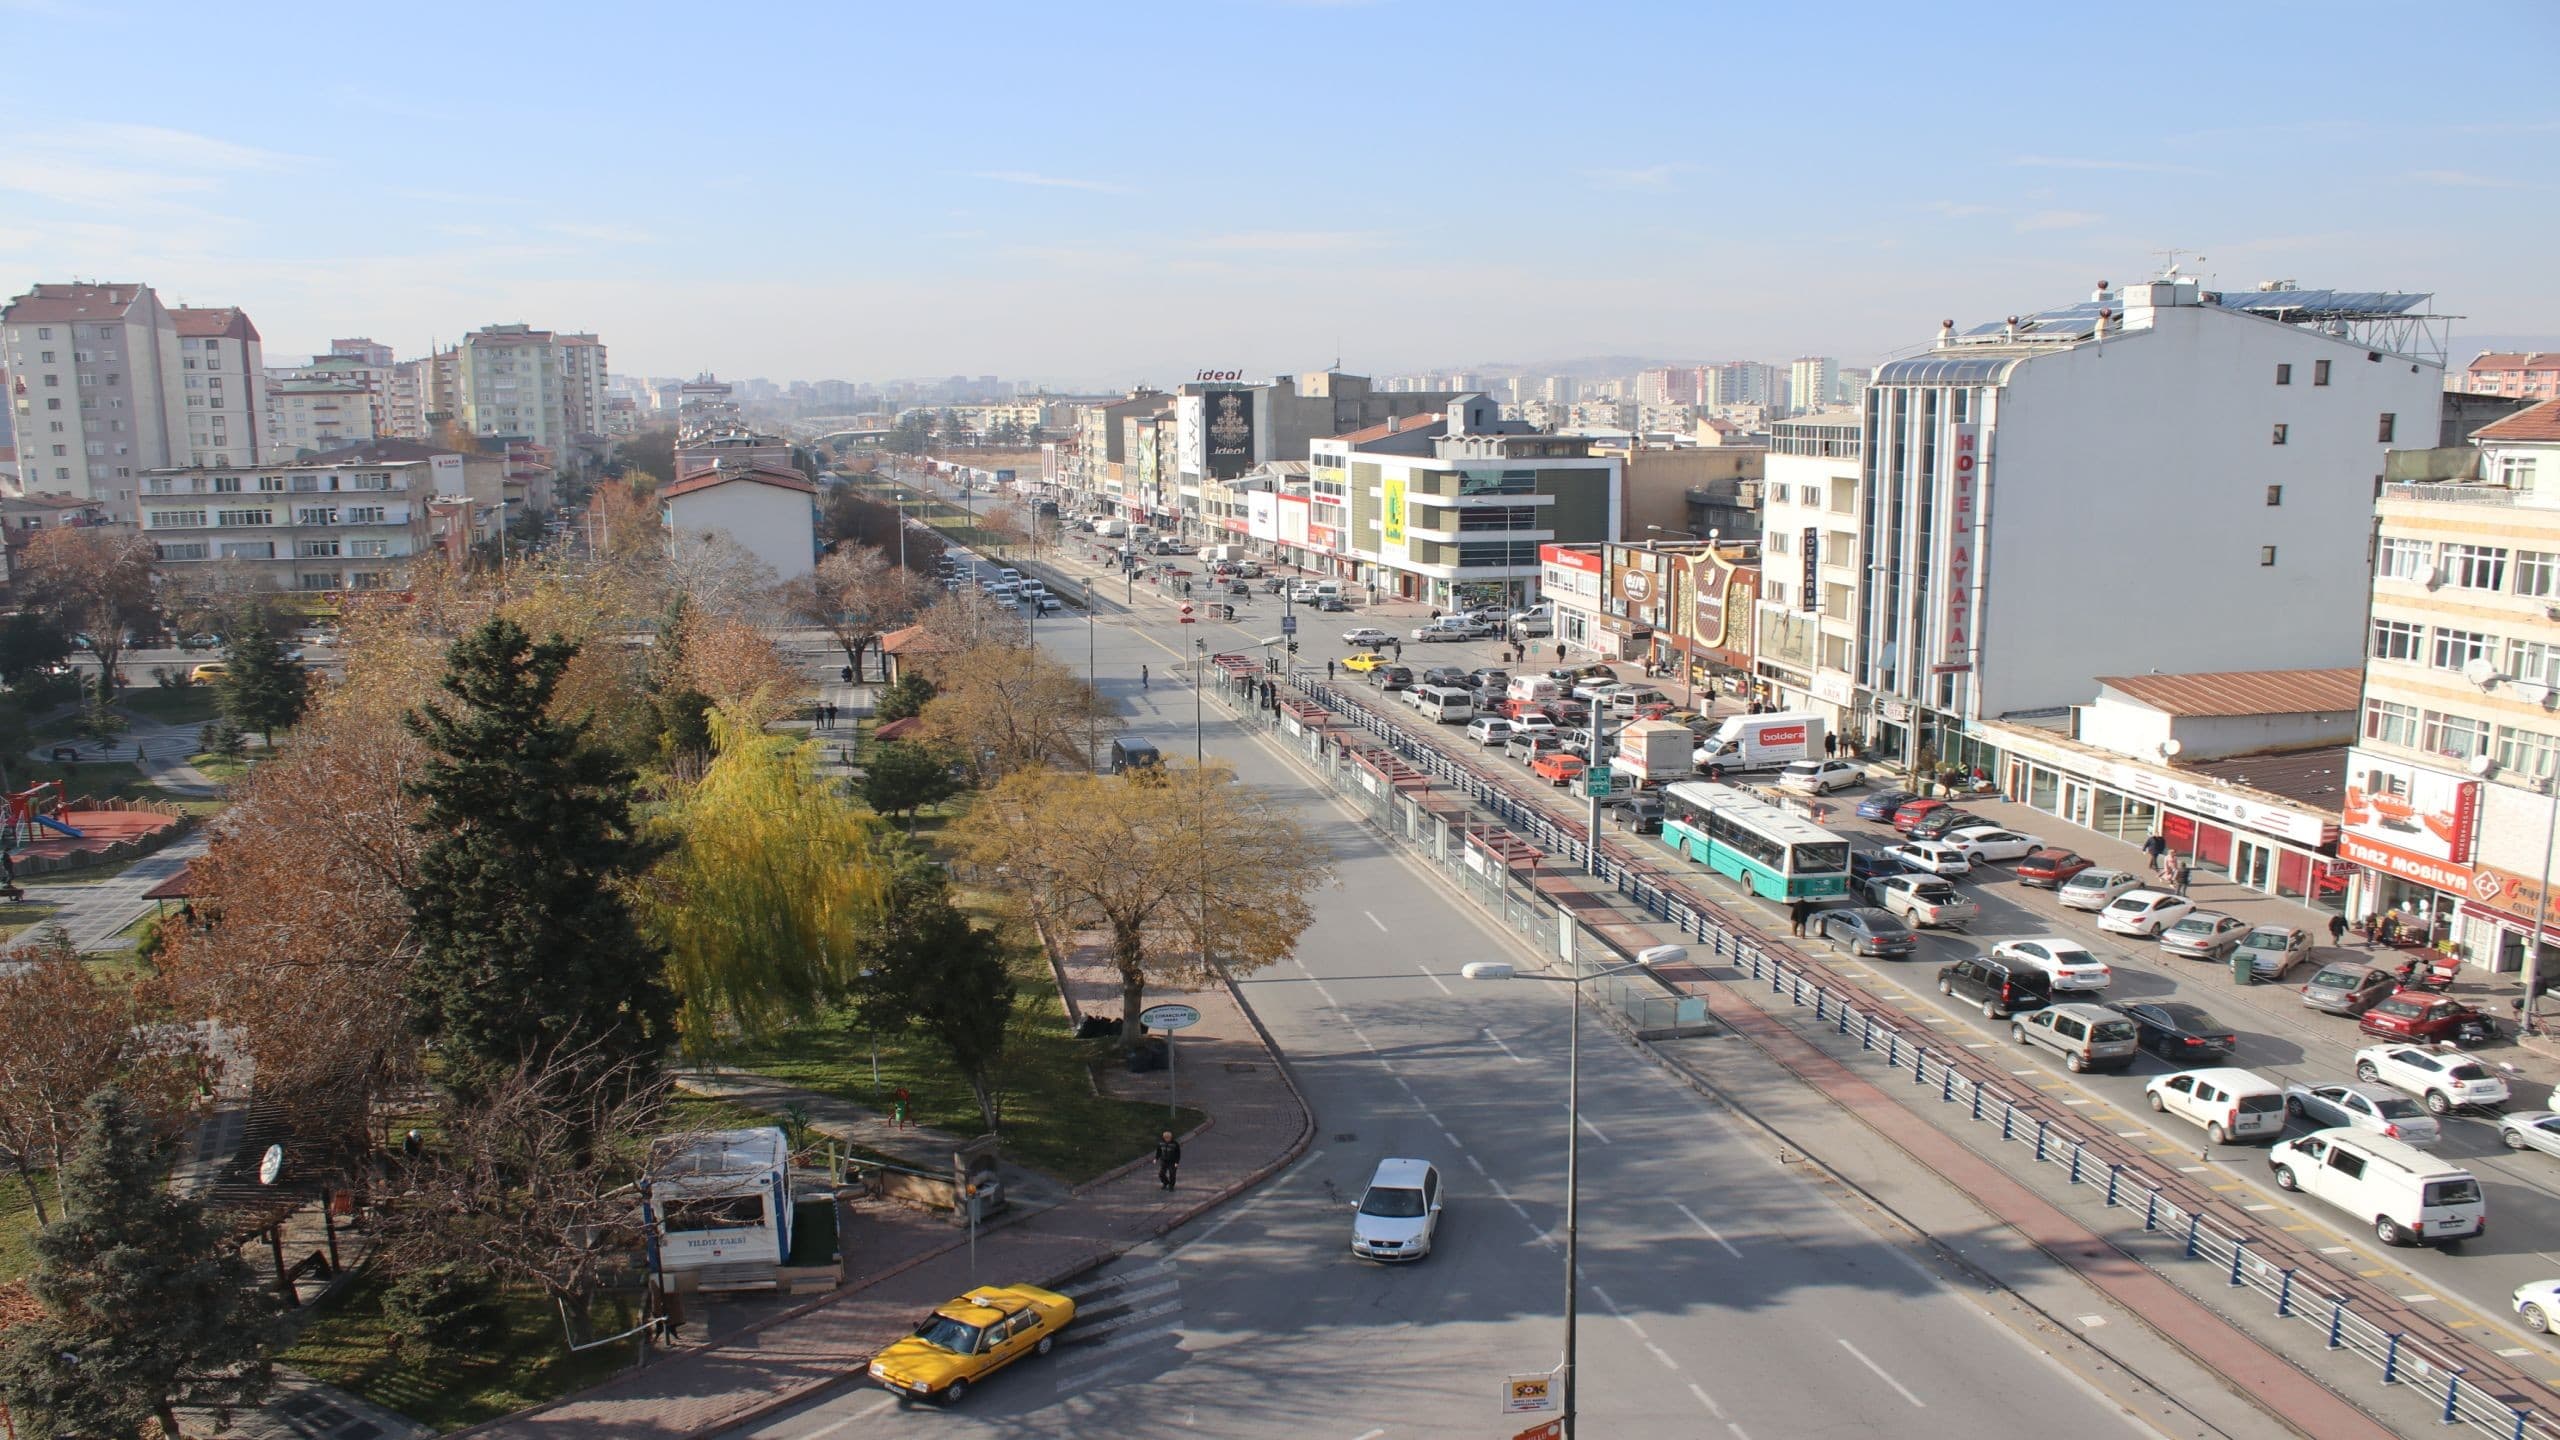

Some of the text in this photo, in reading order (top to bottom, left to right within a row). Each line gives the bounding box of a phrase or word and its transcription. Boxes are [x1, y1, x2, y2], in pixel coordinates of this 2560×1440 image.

[1197, 369, 1242, 380] ideal
[1214, 446, 1246, 454] ideal
[1806, 530, 1817, 570] HOTEL
[1951, 434, 1974, 643] HOTEL AYATA
[2349, 842, 2387, 866] TARZ
[2392, 855, 2468, 891] MOBİLYA
